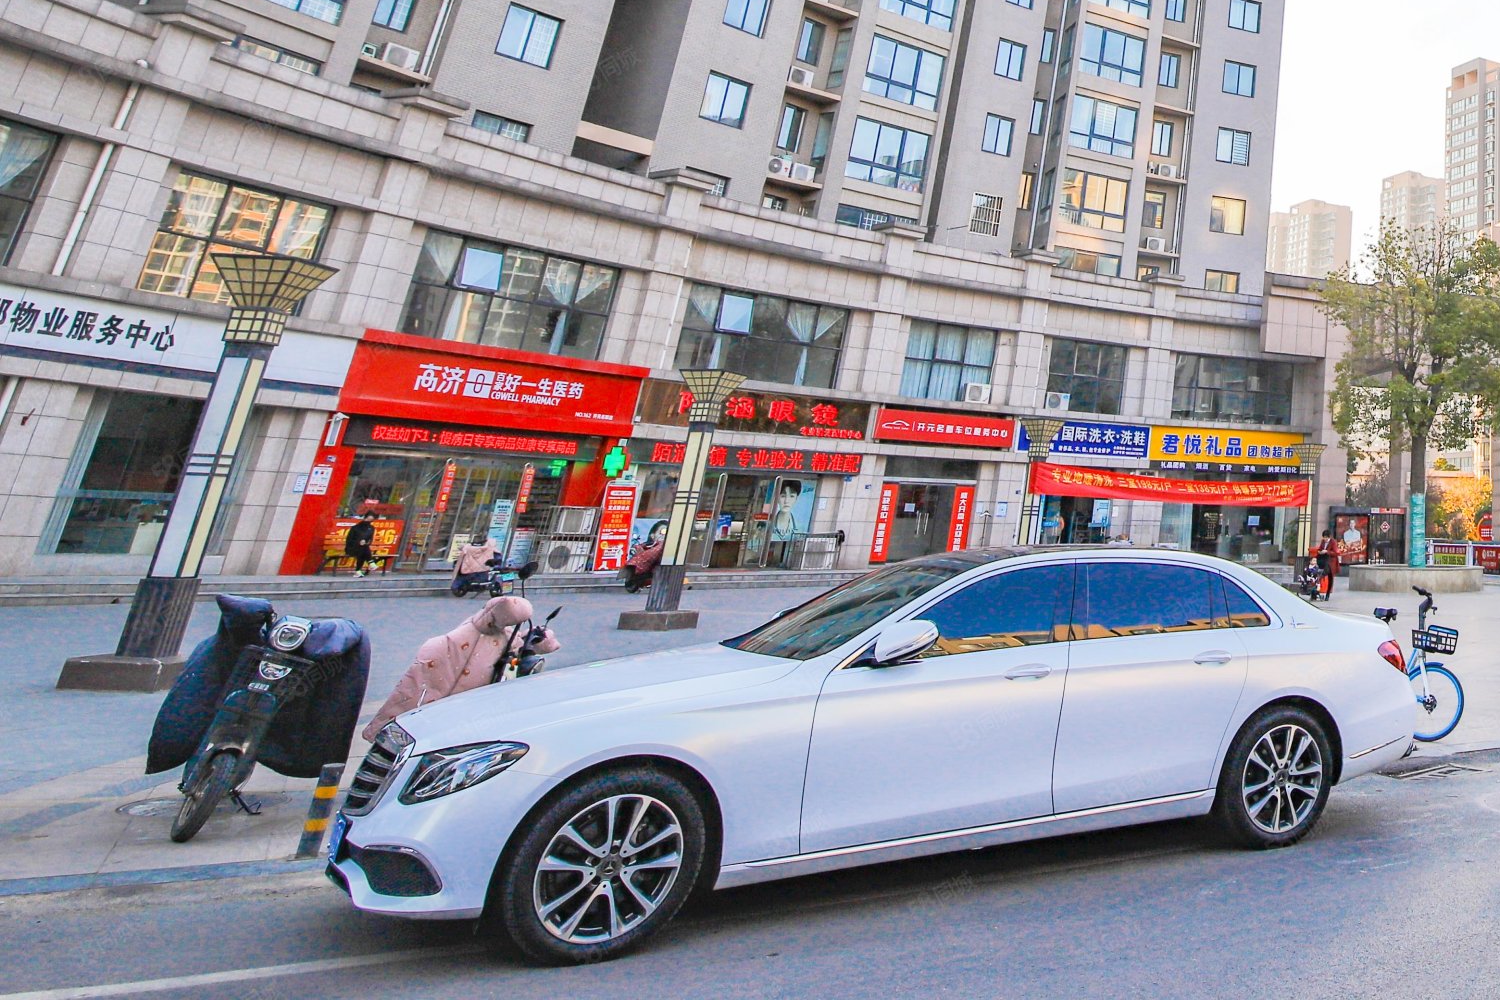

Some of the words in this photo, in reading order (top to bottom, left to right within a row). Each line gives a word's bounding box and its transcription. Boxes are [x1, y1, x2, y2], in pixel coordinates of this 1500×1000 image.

[414, 364, 465, 394] 高济
[521, 394, 560, 406] PHARMACY
[652, 441, 728, 467] 陌涵镜
[736, 448, 803, 470] 专业验光
[1162, 434, 1242, 457] 君悦礼品
[1247, 445, 1294, 459] 团购超市
